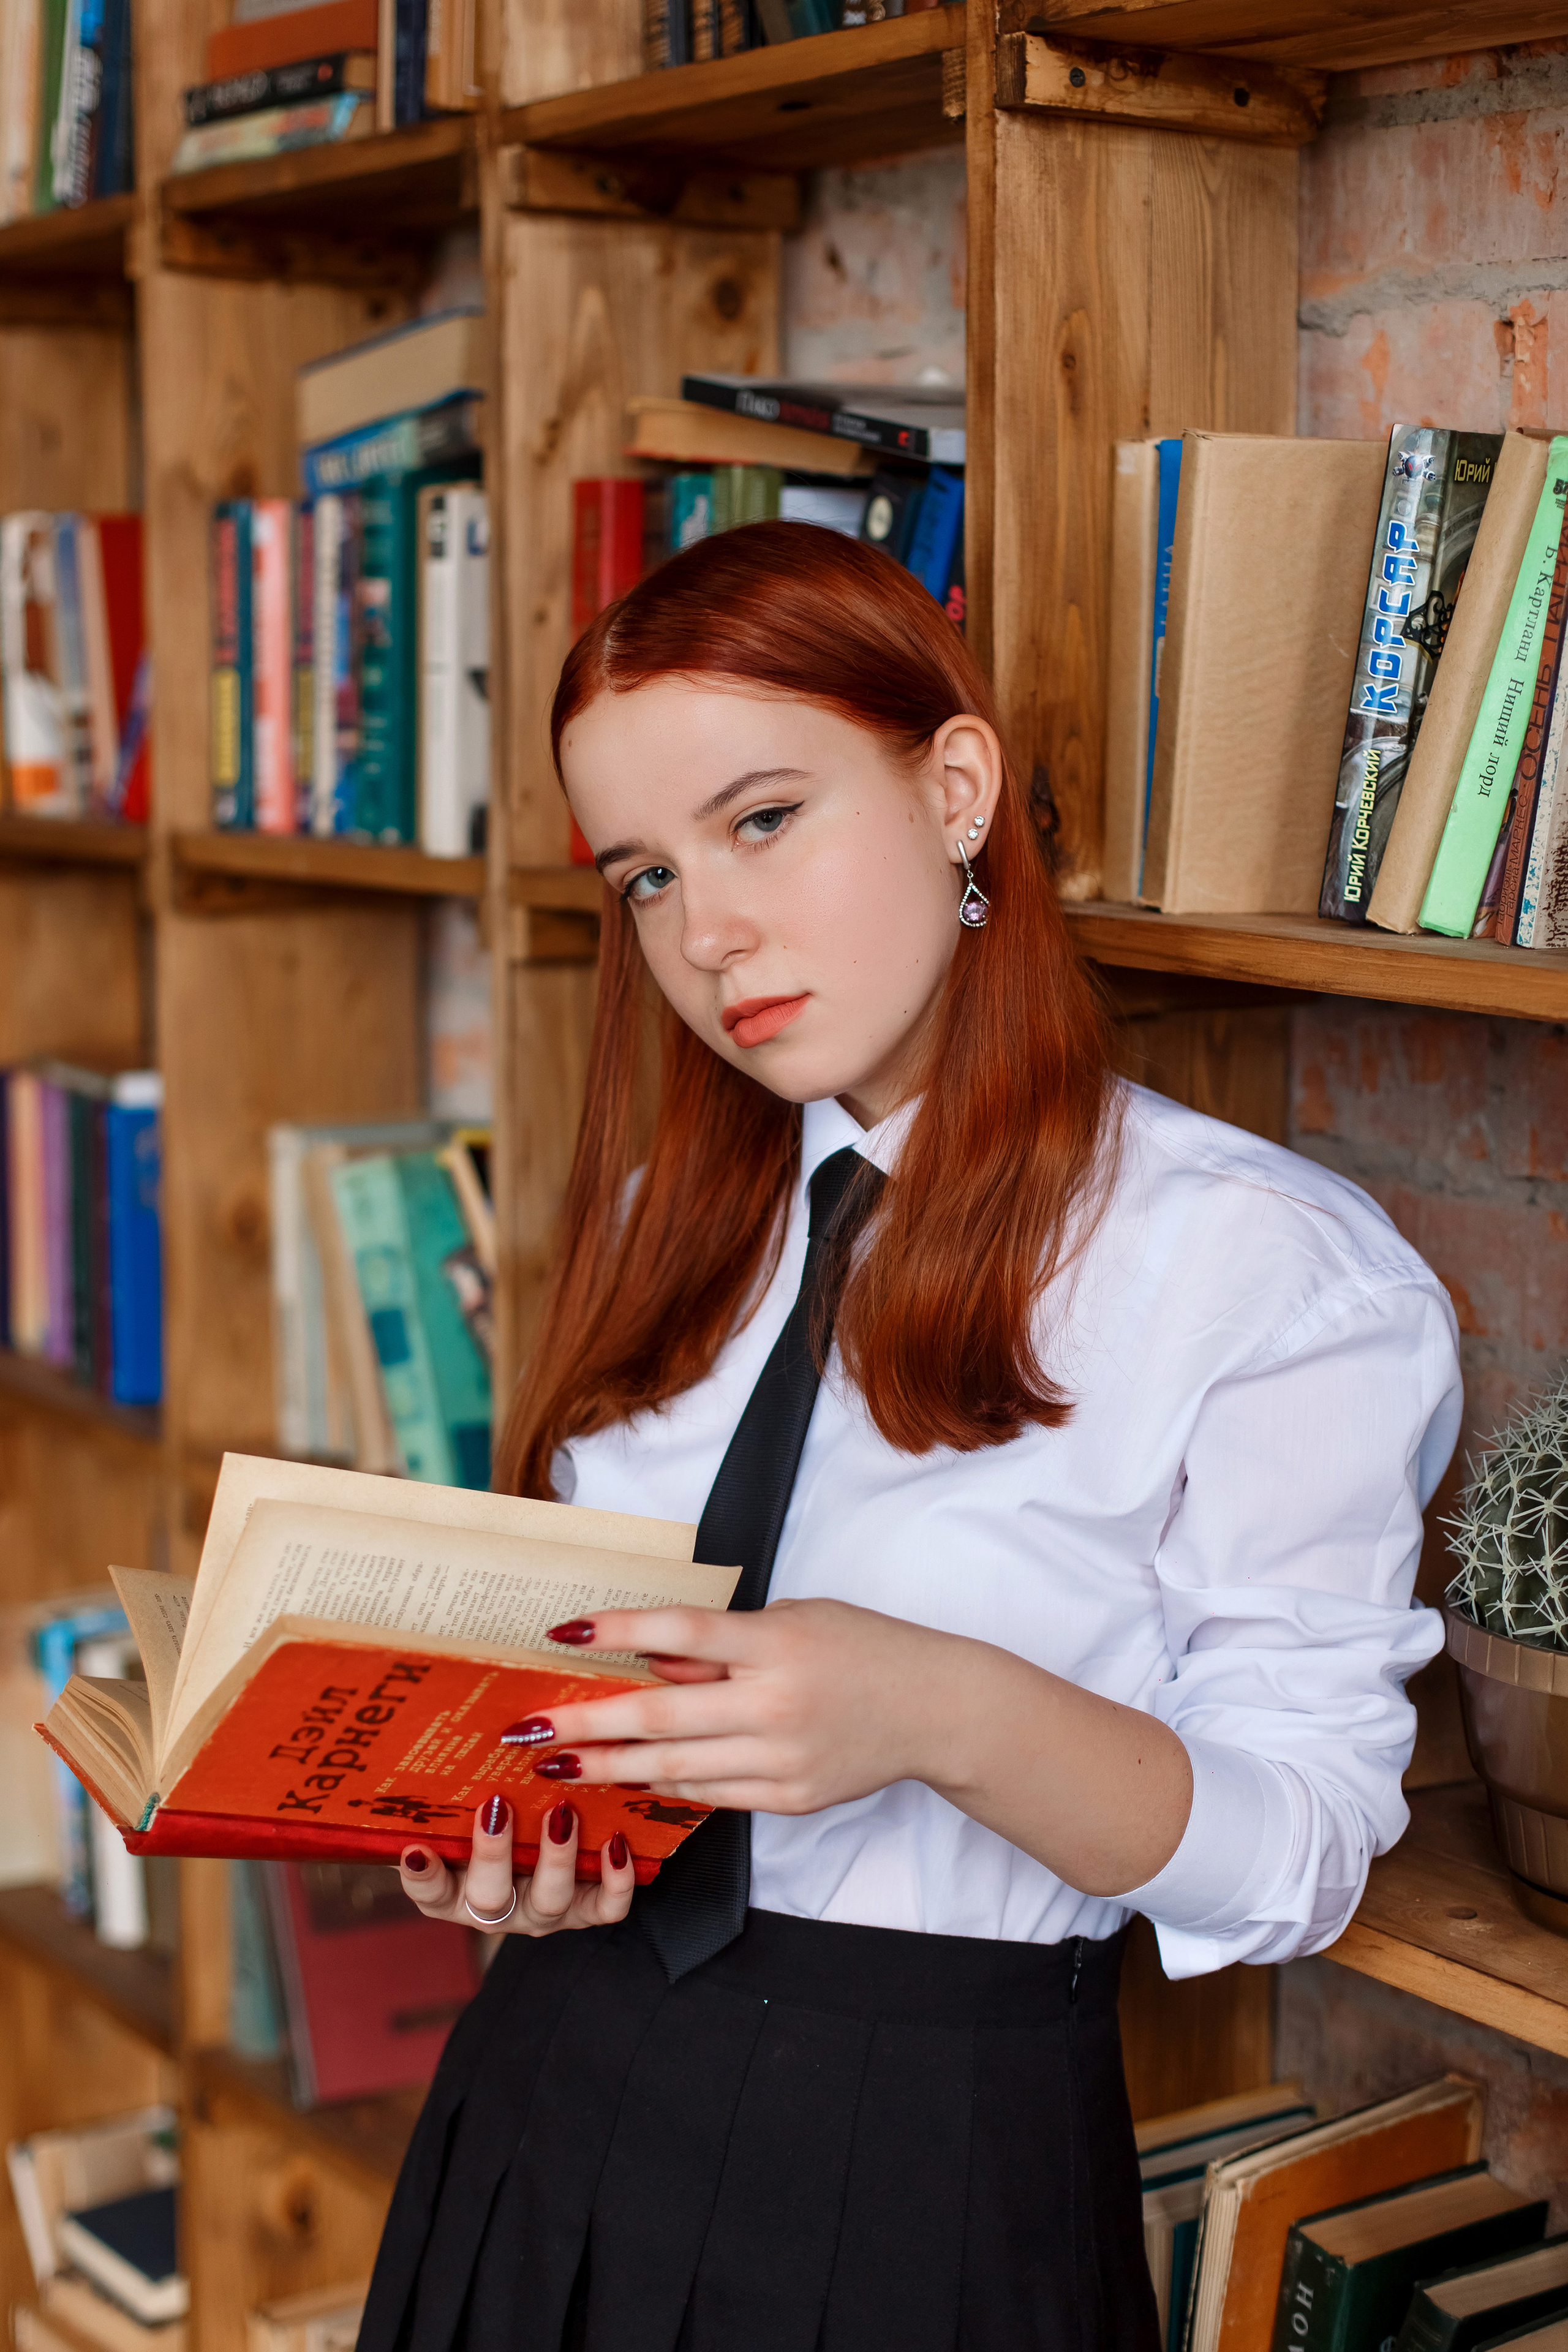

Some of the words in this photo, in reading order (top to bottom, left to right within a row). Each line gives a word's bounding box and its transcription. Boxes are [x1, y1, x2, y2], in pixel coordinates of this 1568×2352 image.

[1360, 521, 1420, 714] КОРСАР
[1515, 571, 1554, 662] Картланд
[1493, 677, 1525, 747] Нищий
[1477, 753, 1500, 798] лорд
[1352, 748, 1381, 850] КОРЧЕВСКИЙ
[1510, 793, 1529, 865] МАРКЕС
[485, 1573, 506, 1615] счастливая
[514, 1599, 524, 1612] как
[521, 1597, 535, 1618] этому
[530, 1597, 543, 1618] своей
[612, 1589, 622, 1601] без
[467, 1615, 480, 1635] своей
[483, 1611, 500, 1642] больше,
[497, 1595, 507, 1608] чем
[528, 1602, 550, 1648] проигрывает
[268, 1686, 358, 1765] Дэйл
[277, 1662, 431, 1814] Карнеги
[409, 1738, 444, 1773] друзей
[437, 1765, 456, 1776] на
[374, 1777, 398, 1793] Как
[451, 1785, 475, 1802] Как
